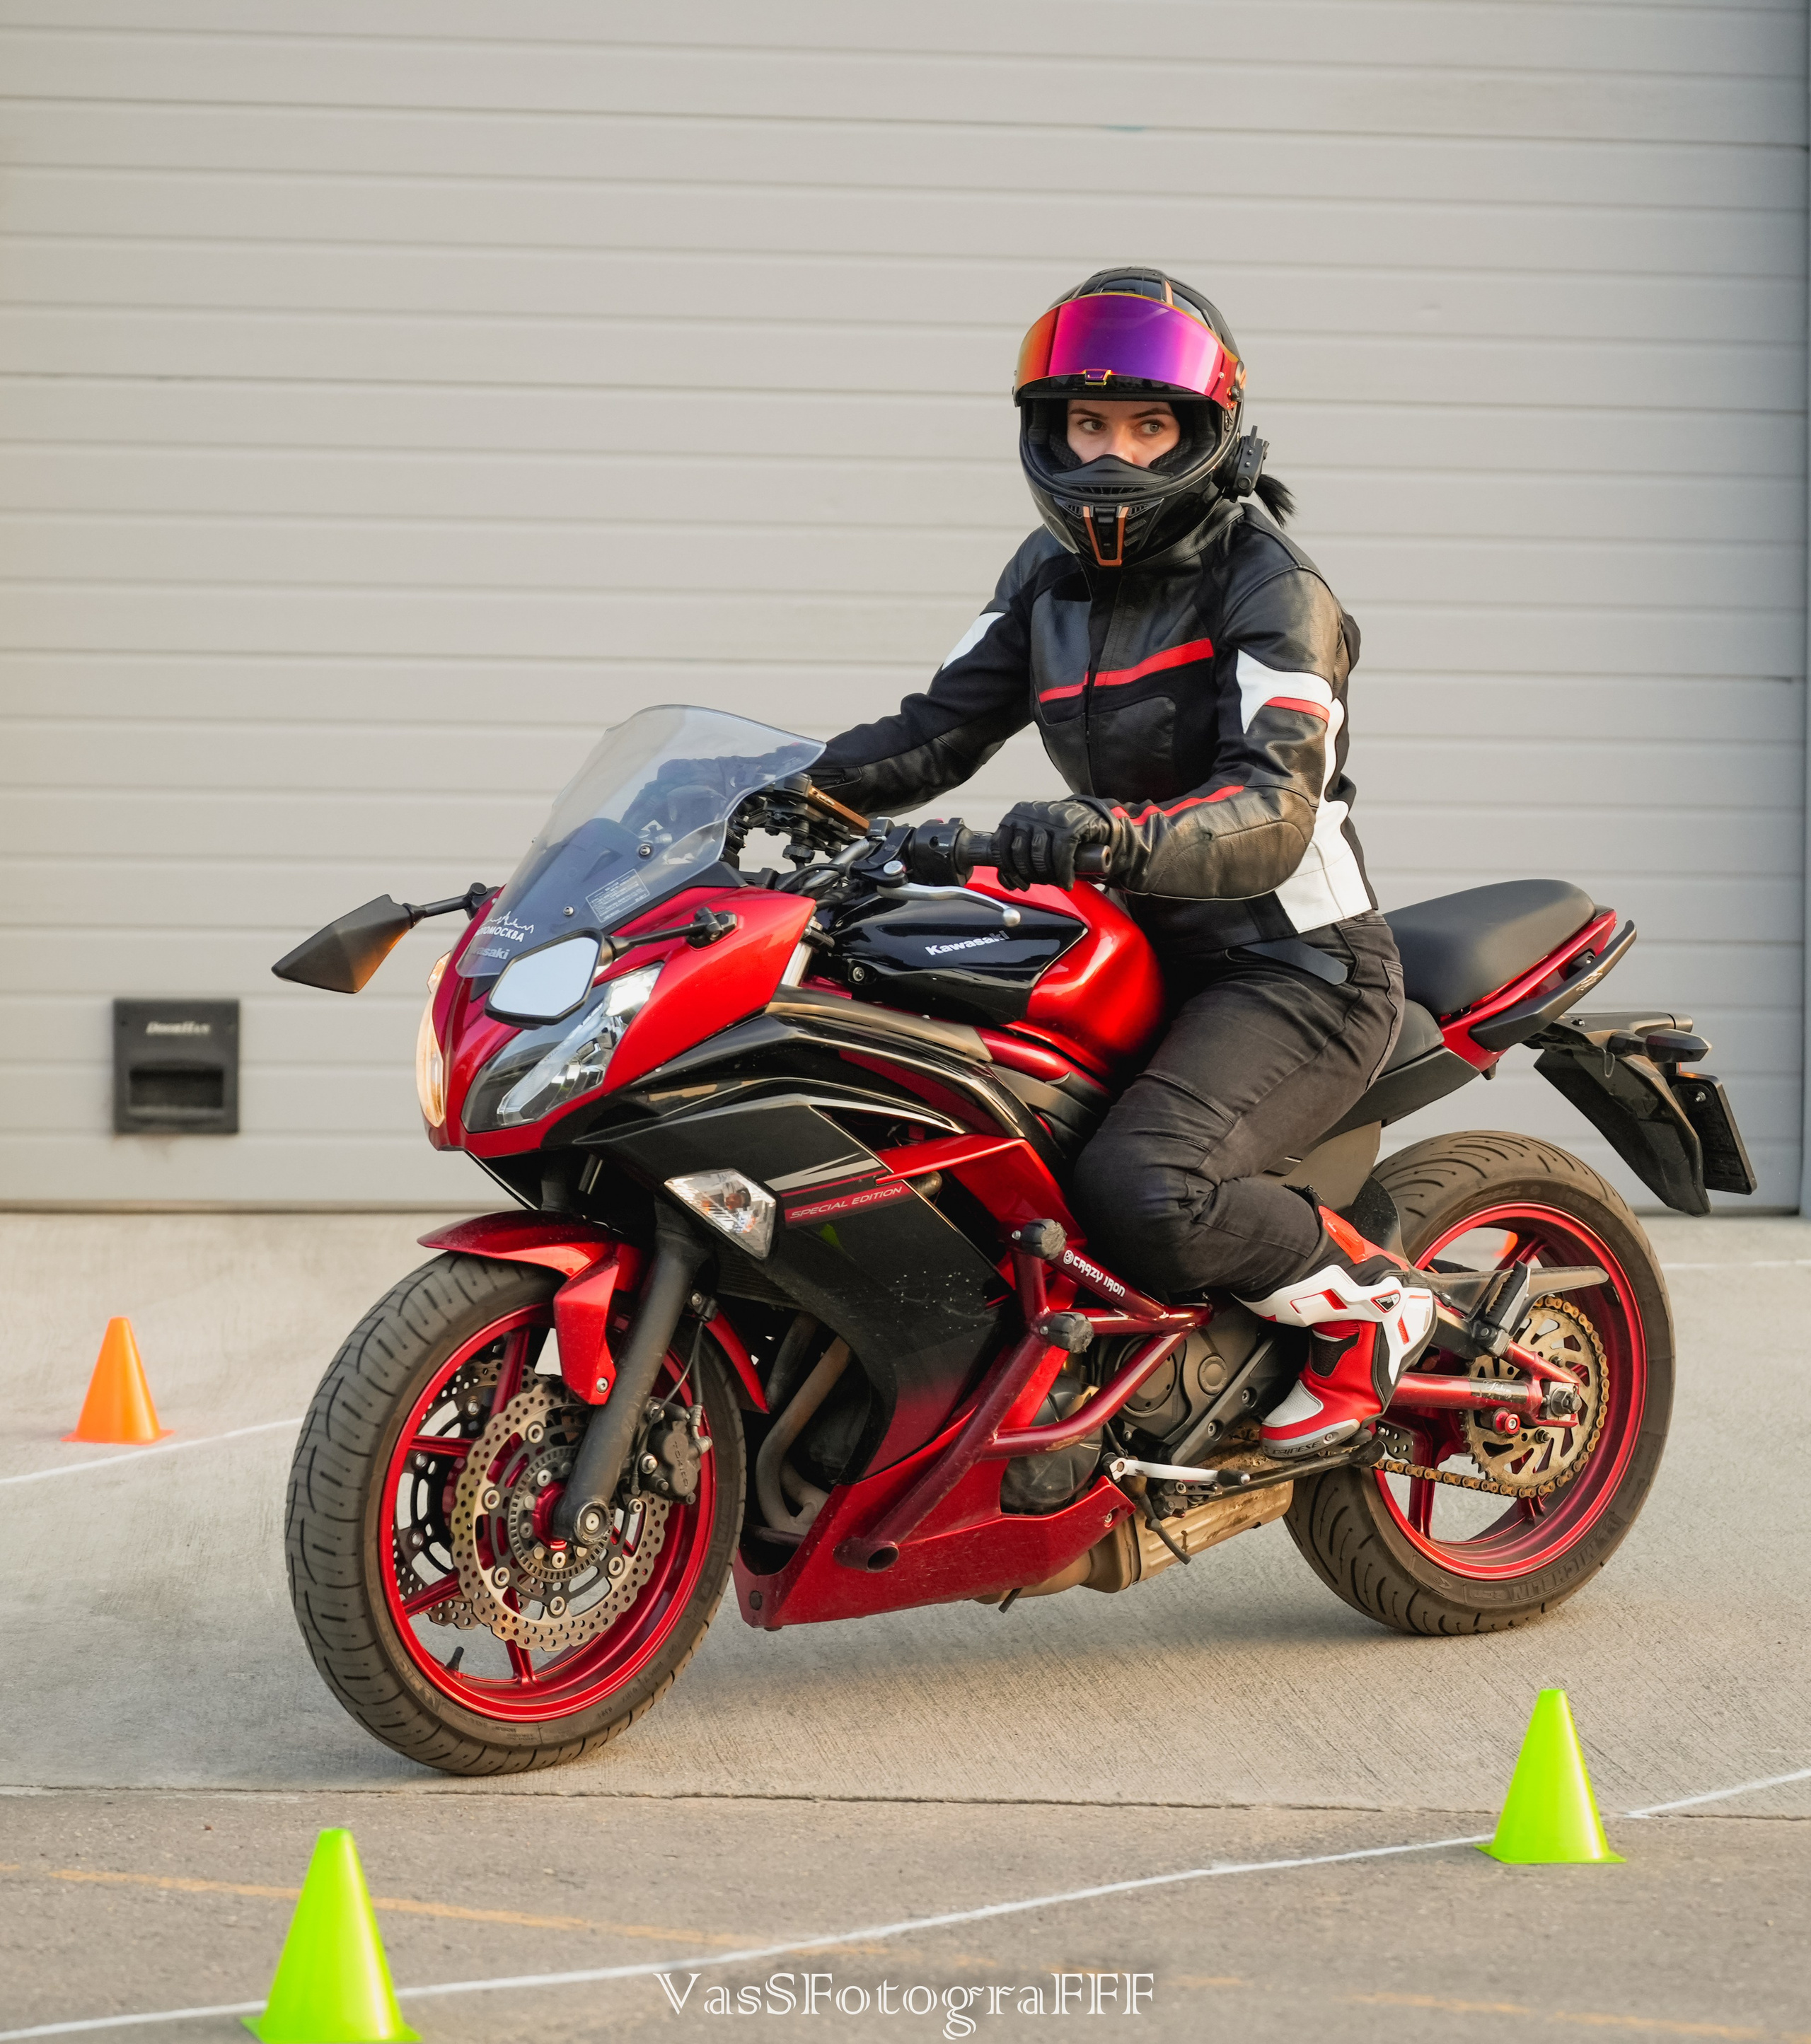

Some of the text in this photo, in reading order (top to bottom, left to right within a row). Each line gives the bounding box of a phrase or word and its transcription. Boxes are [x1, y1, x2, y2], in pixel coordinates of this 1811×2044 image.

[474, 947, 511, 960] asaki
[925, 930, 1010, 956] Kawasaki
[789, 1186, 903, 1219] SPECIAL EDITION
[1072, 1255, 1126, 1297] CRAZY IRON
[672, 1440, 689, 1487] TOKICO
[1512, 1543, 1597, 1601] MICHELIN
